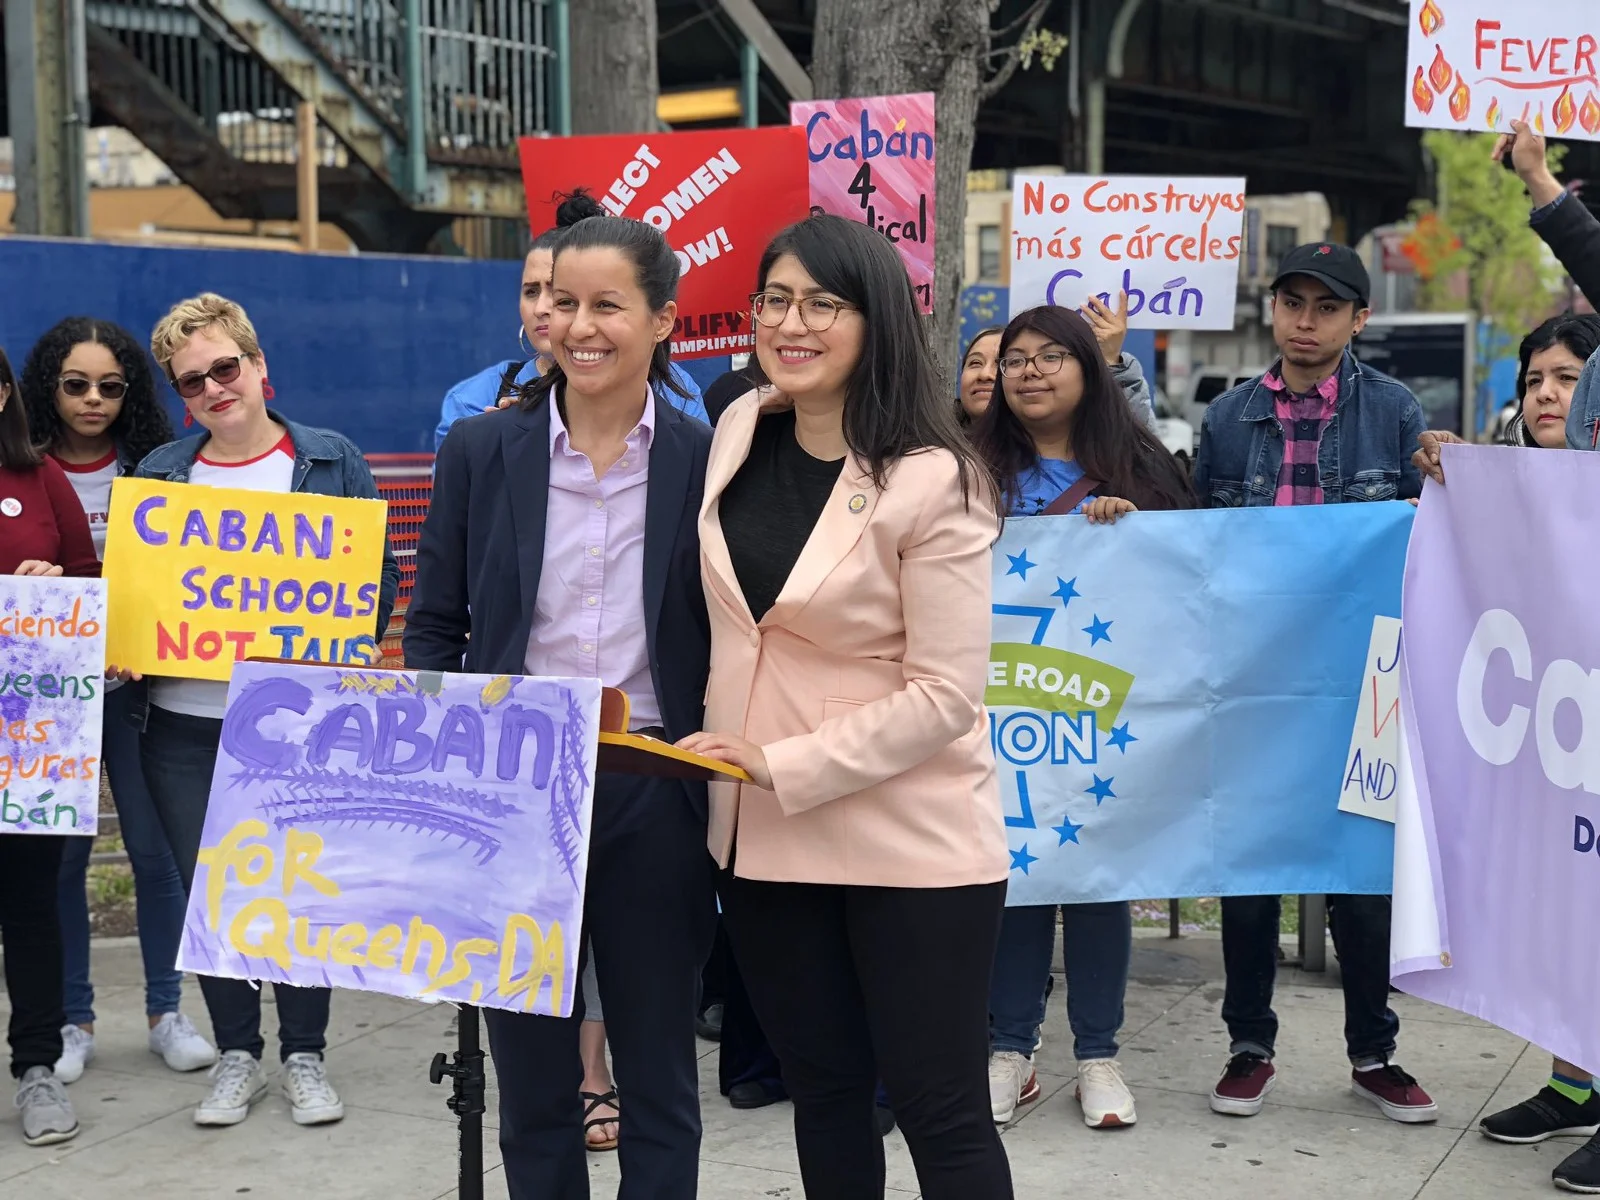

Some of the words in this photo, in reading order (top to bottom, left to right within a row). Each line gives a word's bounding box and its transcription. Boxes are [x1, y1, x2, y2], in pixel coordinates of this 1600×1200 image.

[1475, 19, 1598, 76] FEVER
[642, 147, 742, 235] OMEN
[848, 161, 877, 209] 4
[1023, 180, 1070, 216] No
[1082, 179, 1246, 222] Construyas
[674, 226, 734, 278] OW!
[1012, 226, 1082, 260] más
[1100, 221, 1242, 262] cárceles
[670, 333, 756, 355] AMPLIFYHE
[181, 565, 378, 619] SCHOOLS
[0, 596, 100, 638] ciendo
[156, 621, 257, 661] NOT
[1014, 662, 1111, 708] ROAD
[0, 753, 98, 790] guras
[1344, 747, 1397, 802] AND
[1, 788, 78, 829] bán
